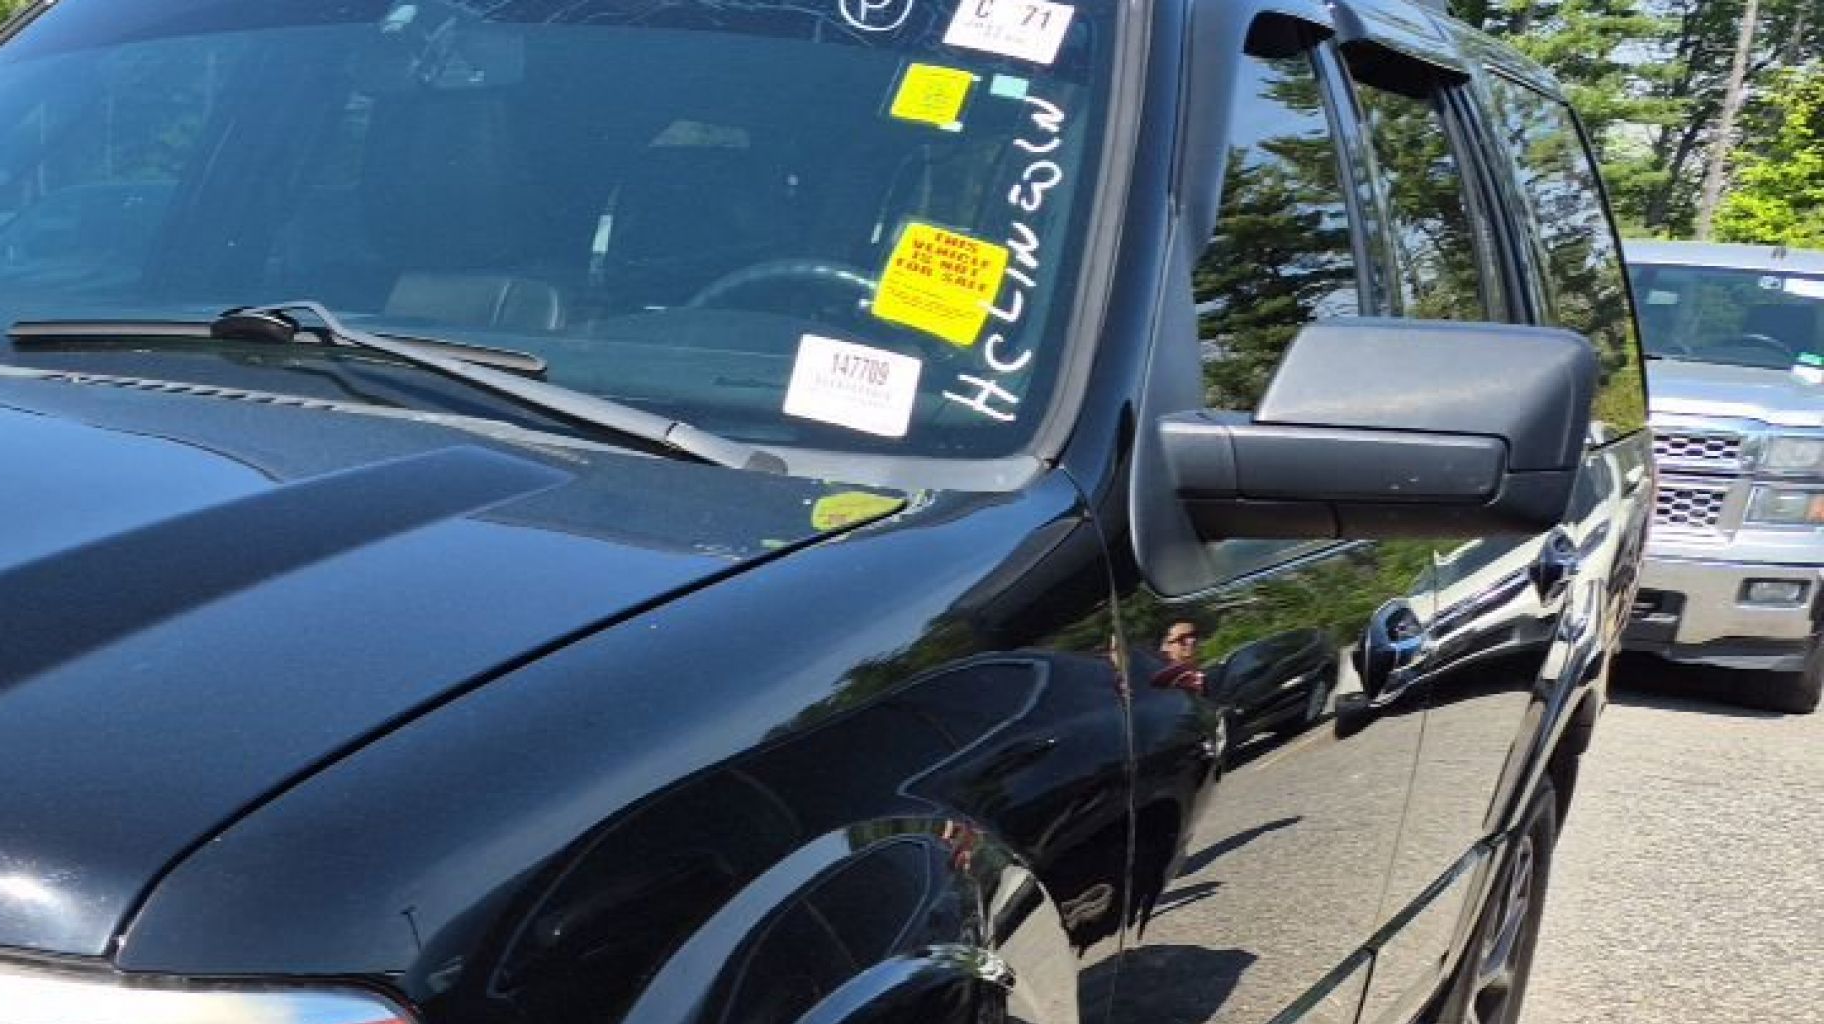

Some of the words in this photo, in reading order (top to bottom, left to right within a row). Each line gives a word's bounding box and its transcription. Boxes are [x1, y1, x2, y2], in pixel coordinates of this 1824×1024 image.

[911, 239, 991, 269] VEHICLE
[934, 231, 979, 254] THIS
[895, 257, 933, 277] FOR
[940, 272, 987, 293] SALE
[911, 250, 933, 264] IS
[939, 260, 978, 278] NOT
